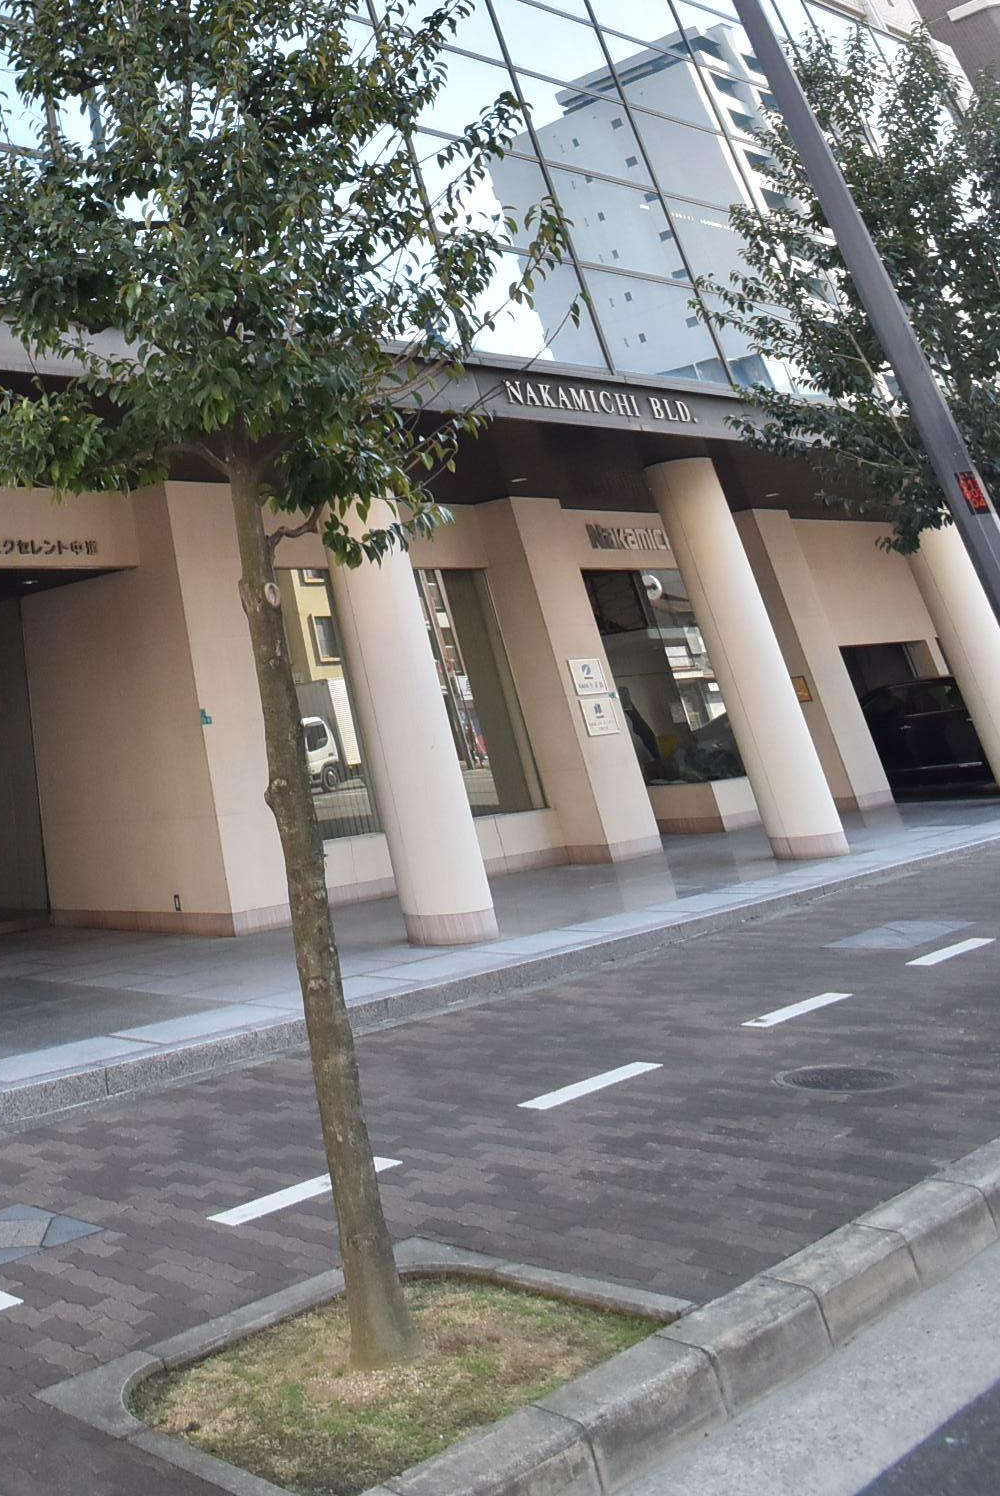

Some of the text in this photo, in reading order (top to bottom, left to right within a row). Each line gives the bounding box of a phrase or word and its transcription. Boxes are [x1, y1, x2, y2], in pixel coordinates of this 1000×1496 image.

[505, 380, 698, 423] NAKAMICHI BLD.
[585, 523, 671, 552] Nakamic
